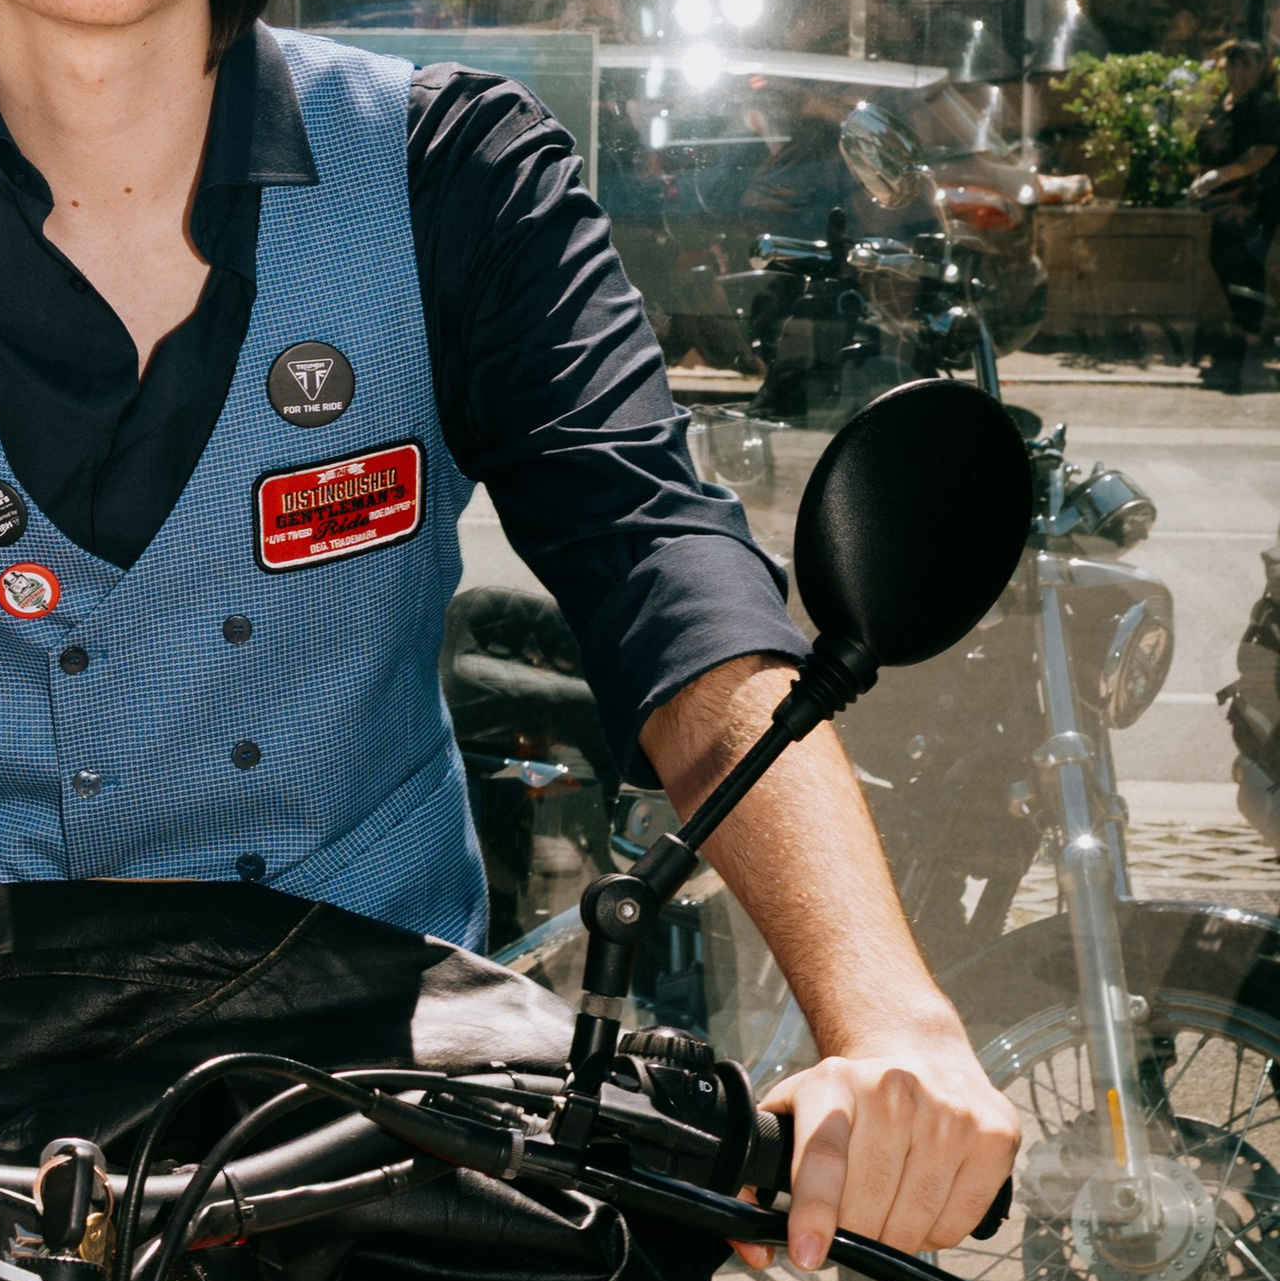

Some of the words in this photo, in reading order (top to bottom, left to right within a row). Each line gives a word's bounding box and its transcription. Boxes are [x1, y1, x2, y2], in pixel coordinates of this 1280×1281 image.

[283, 405, 301, 414] FOR
[303, 404, 321, 412] THE
[322, 401, 343, 411] RIDE
[282, 467, 397, 514] DISTINGUISHED
[275, 485, 405, 529] GENTLEMAN'S
[269, 532, 286, 544] LIVE
[287, 528, 313, 540] TWEED
[312, 513, 371, 540] Ride
[329, 529, 378, 549] TRADEMARK
